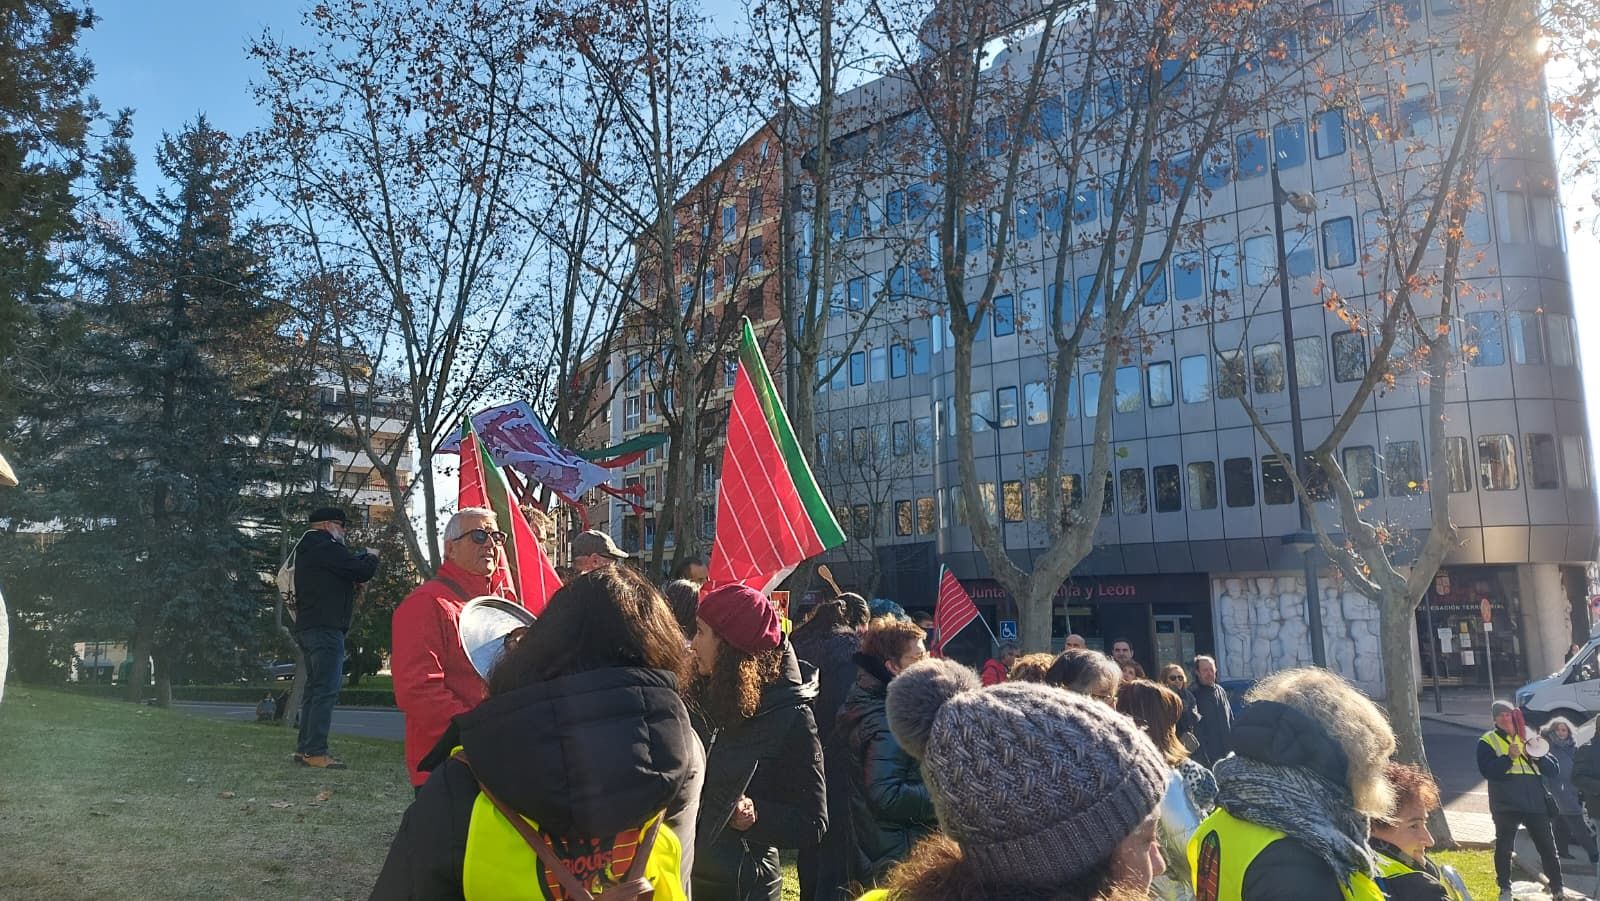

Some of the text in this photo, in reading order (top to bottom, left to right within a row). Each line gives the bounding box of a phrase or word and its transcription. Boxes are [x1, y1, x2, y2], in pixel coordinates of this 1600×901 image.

[970, 583, 1006, 599] Junta
[1085, 586, 1094, 600] y
[1098, 582, 1137, 597] León
